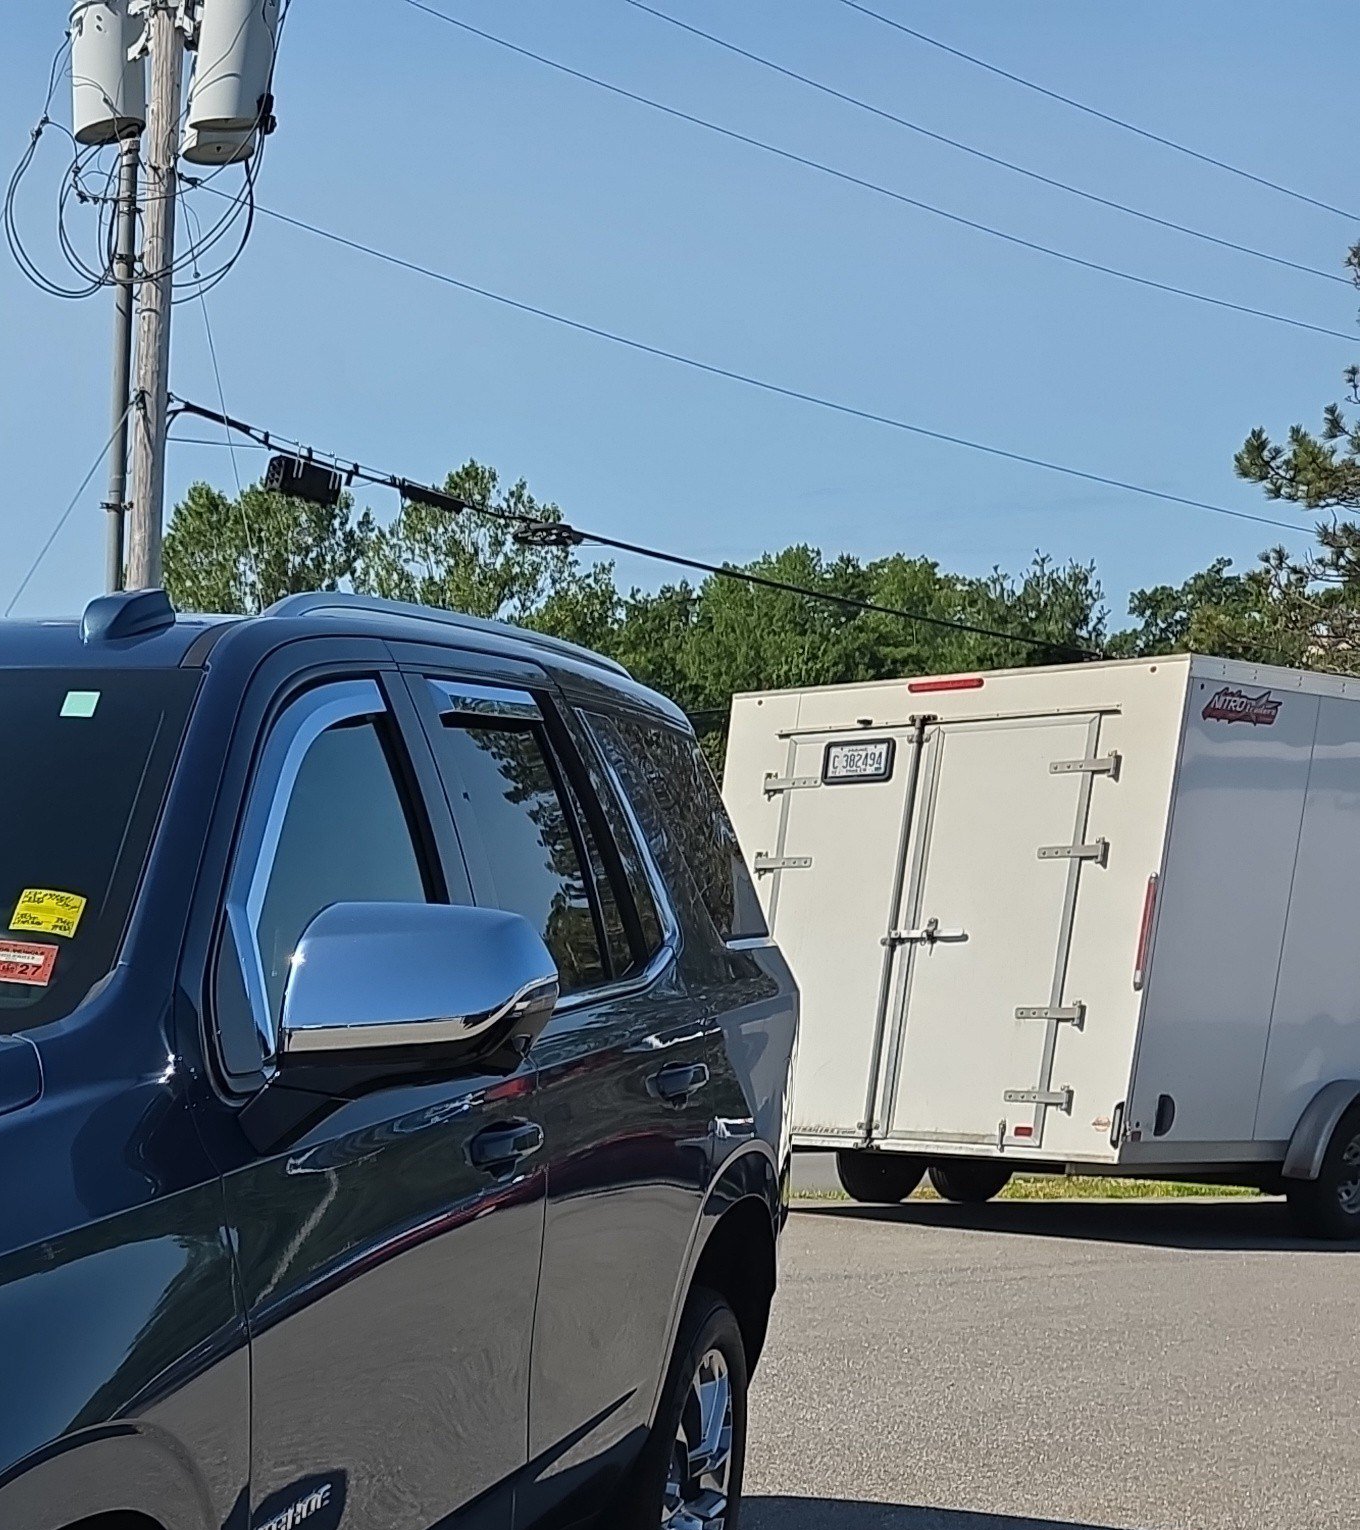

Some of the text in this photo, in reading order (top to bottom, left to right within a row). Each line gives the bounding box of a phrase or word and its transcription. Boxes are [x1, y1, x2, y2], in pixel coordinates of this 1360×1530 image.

[1211, 695, 1248, 712] NITRO
[842, 751, 883, 769] 382494
[18, 964, 43, 976] 27
